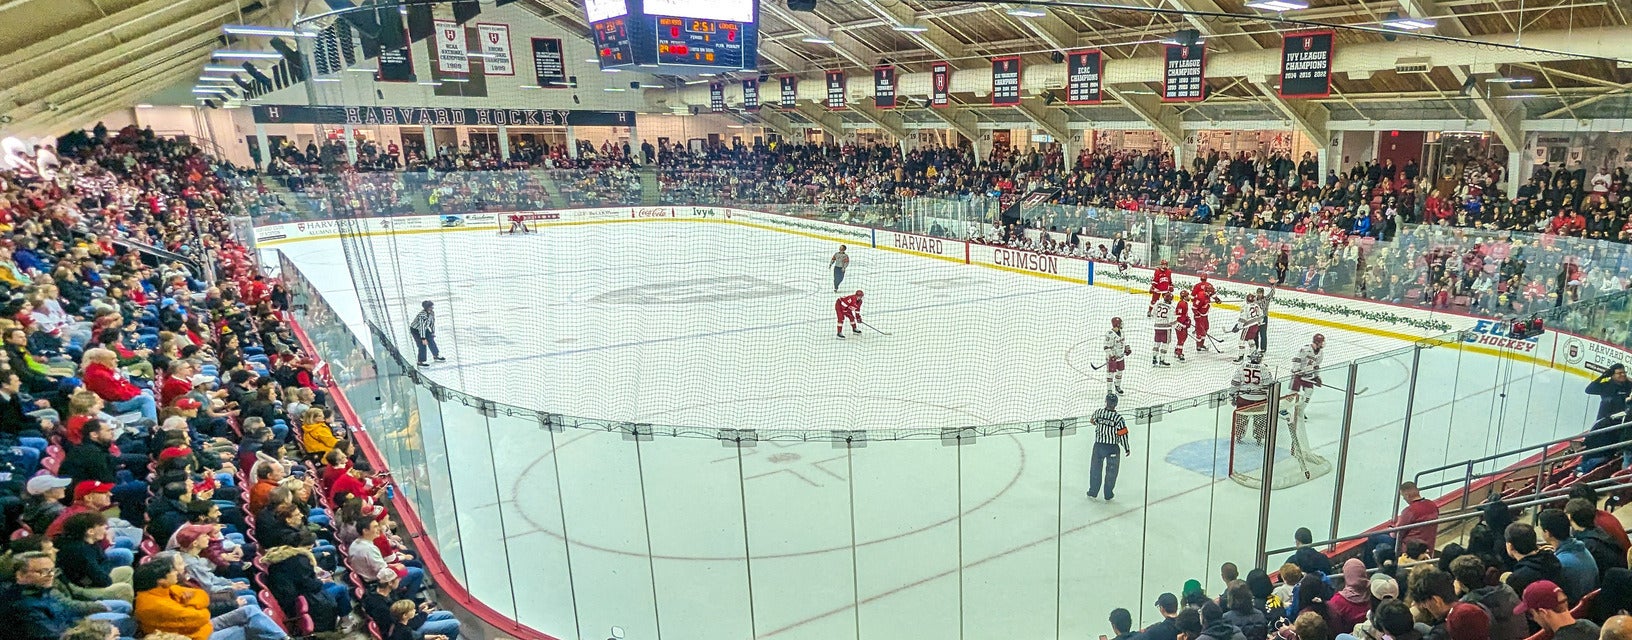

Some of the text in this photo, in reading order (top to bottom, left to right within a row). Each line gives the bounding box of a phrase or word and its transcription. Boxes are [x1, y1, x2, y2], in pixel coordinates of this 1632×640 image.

[693, 20, 714, 32] 2:51
[1287, 51, 1327, 61] IVY LEAGUE
[1168, 59, 1201, 68] IVY LEAGUE
[1285, 60, 1327, 70] CHAMPIONS
[1070, 73, 1099, 82] CHAMPIONS
[1168, 67, 1201, 77] CHAMPIONS
[269, 107, 280, 118] H
[345, 107, 570, 126] HARVARD HOCKEY
[619, 112, 626, 122] H
[1187, 136, 1194, 144] 16
[1332, 138, 1339, 147] 15
[692, 207, 707, 218] Ivy
[894, 233, 943, 255] HARVARD
[994, 248, 1058, 274] CRIMSON
[1157, 306, 1168, 318] 22
[1477, 335, 1536, 352] HOCKEY
[1588, 342, 1623, 361] HARVARD
[1243, 368, 1261, 385] 35
